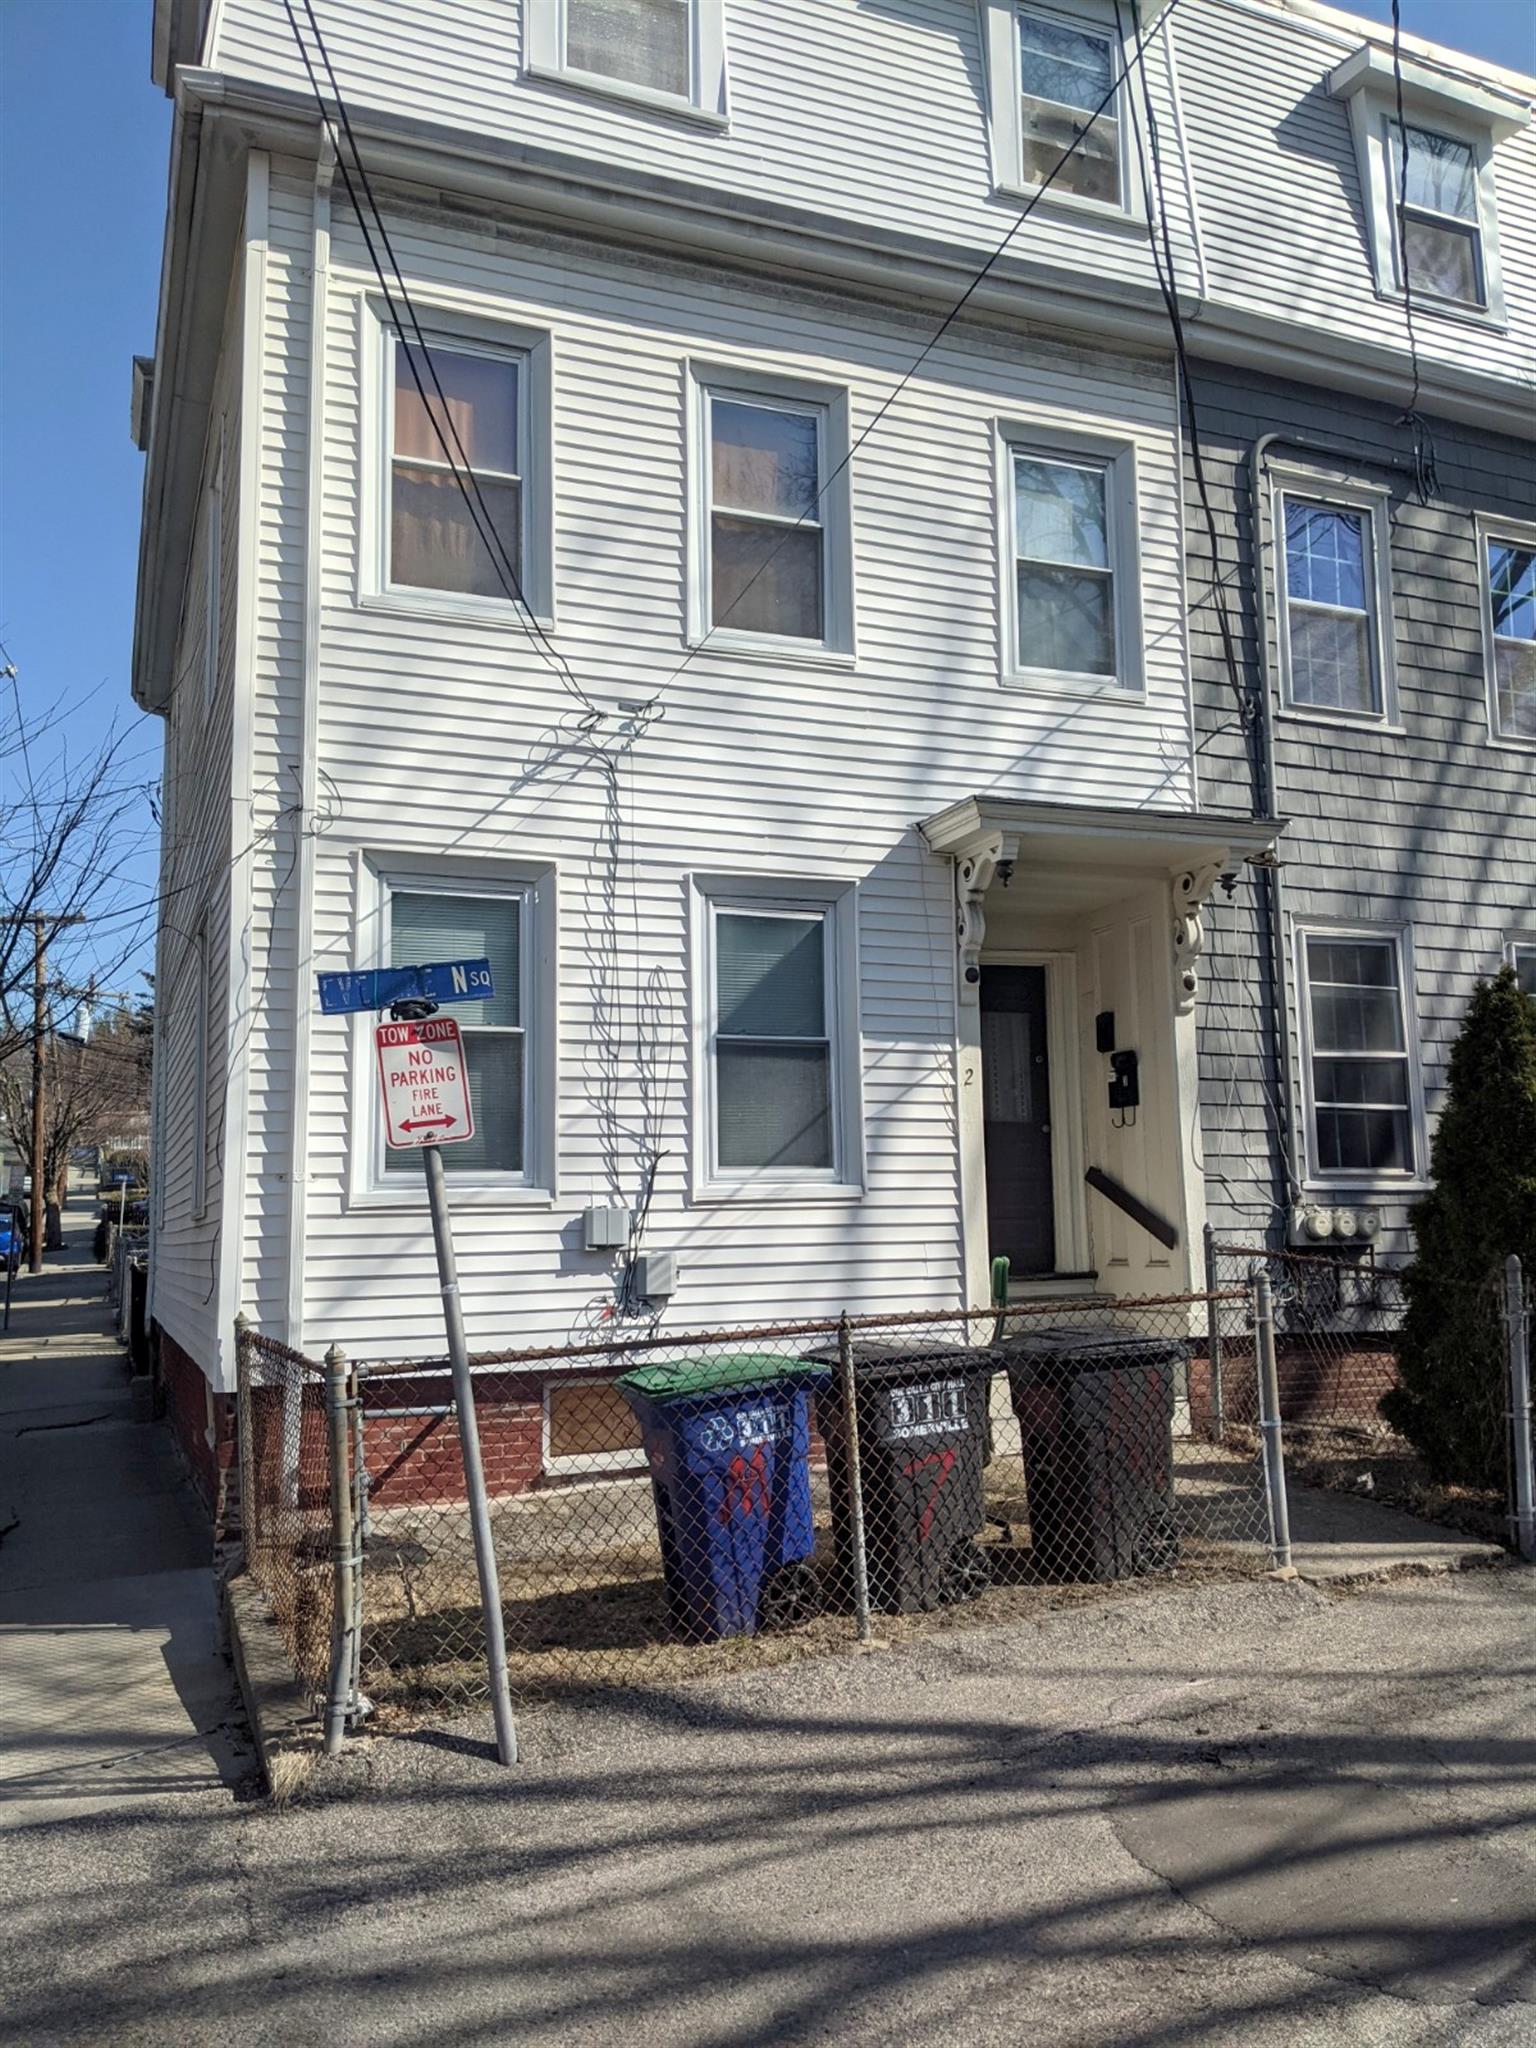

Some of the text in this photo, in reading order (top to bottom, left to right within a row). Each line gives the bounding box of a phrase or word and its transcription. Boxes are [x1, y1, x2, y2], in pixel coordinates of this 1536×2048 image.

[470, 970, 491, 986] SQ
[379, 1021, 457, 1044] TOW ZONE
[408, 1049, 433, 1066] NO
[390, 1066, 456, 1087] PARKING
[964, 1068, 974, 1087] 2
[412, 1087, 439, 1101] FIRE
[412, 1103, 443, 1117] LANE
[895, 1391, 961, 1423] 311
